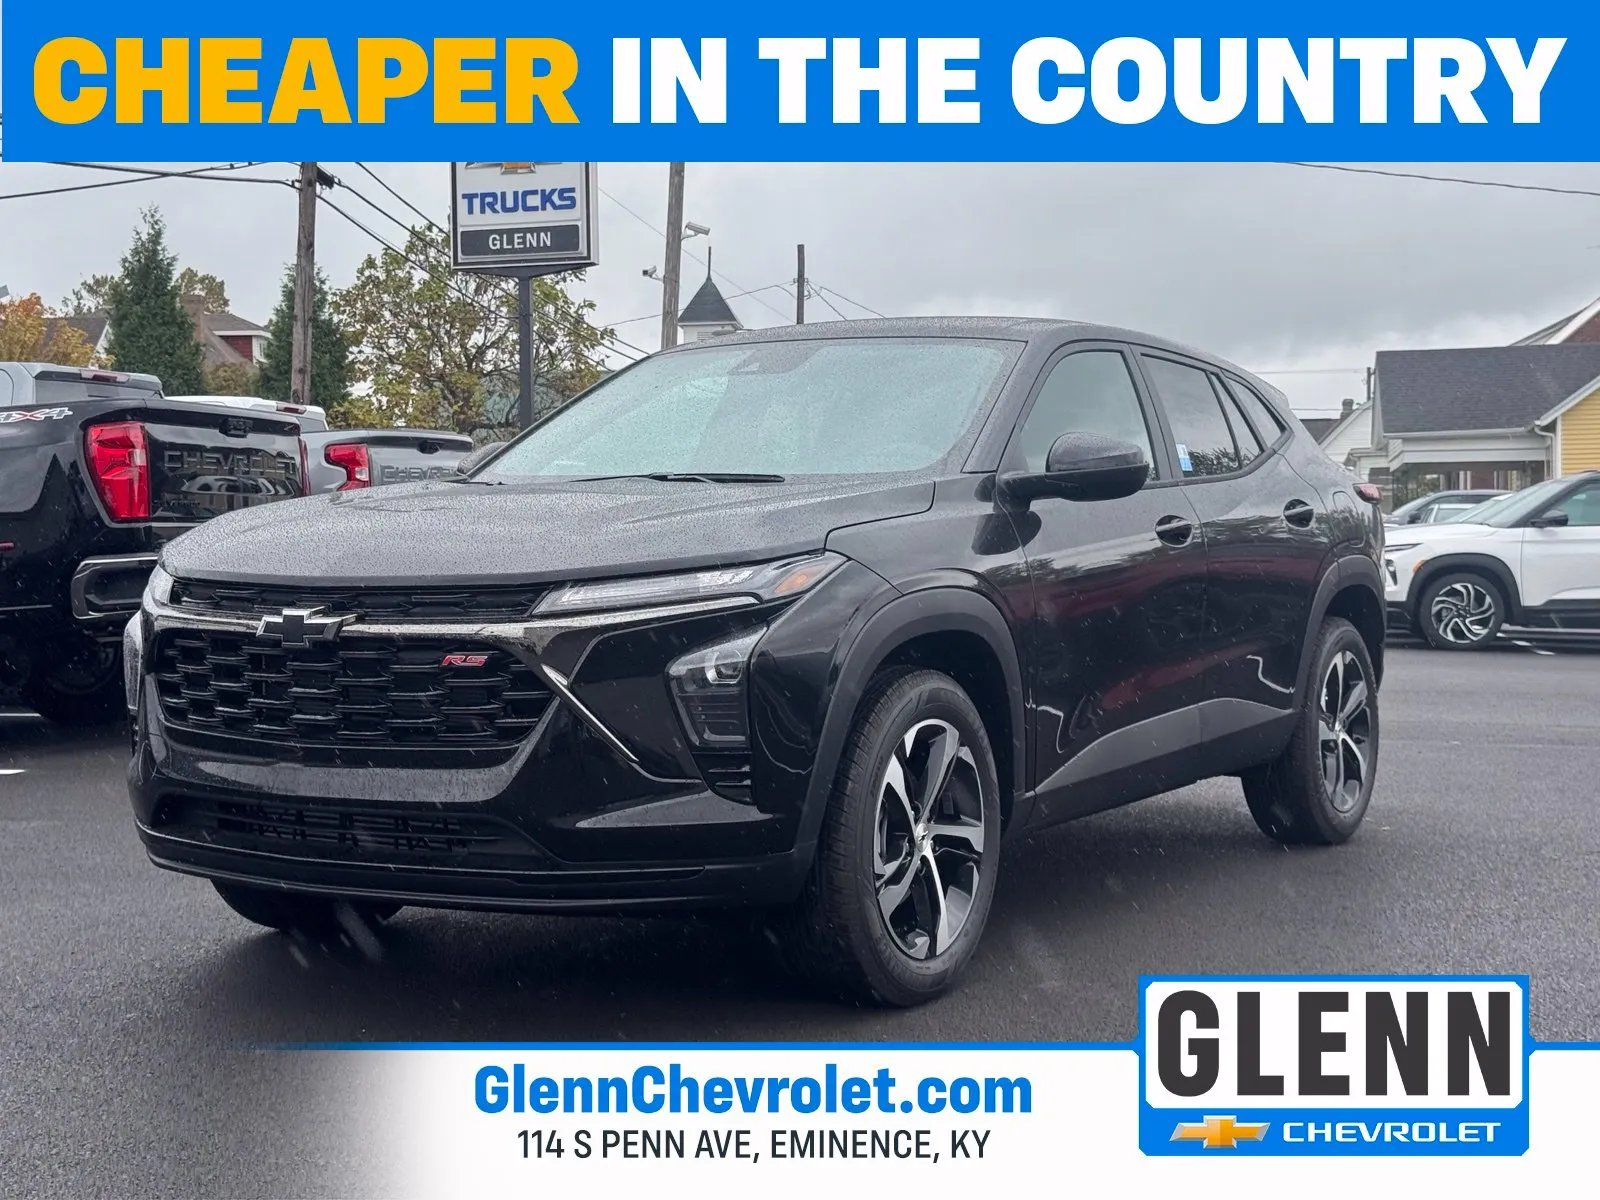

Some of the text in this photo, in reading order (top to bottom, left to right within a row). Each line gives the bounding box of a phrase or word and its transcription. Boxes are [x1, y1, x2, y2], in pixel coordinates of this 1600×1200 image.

[462, 187, 577, 215] TRUCKS
[488, 231, 551, 250] GLENN
[164, 450, 296, 474] CHEVROLET
[442, 655, 488, 666] RS
